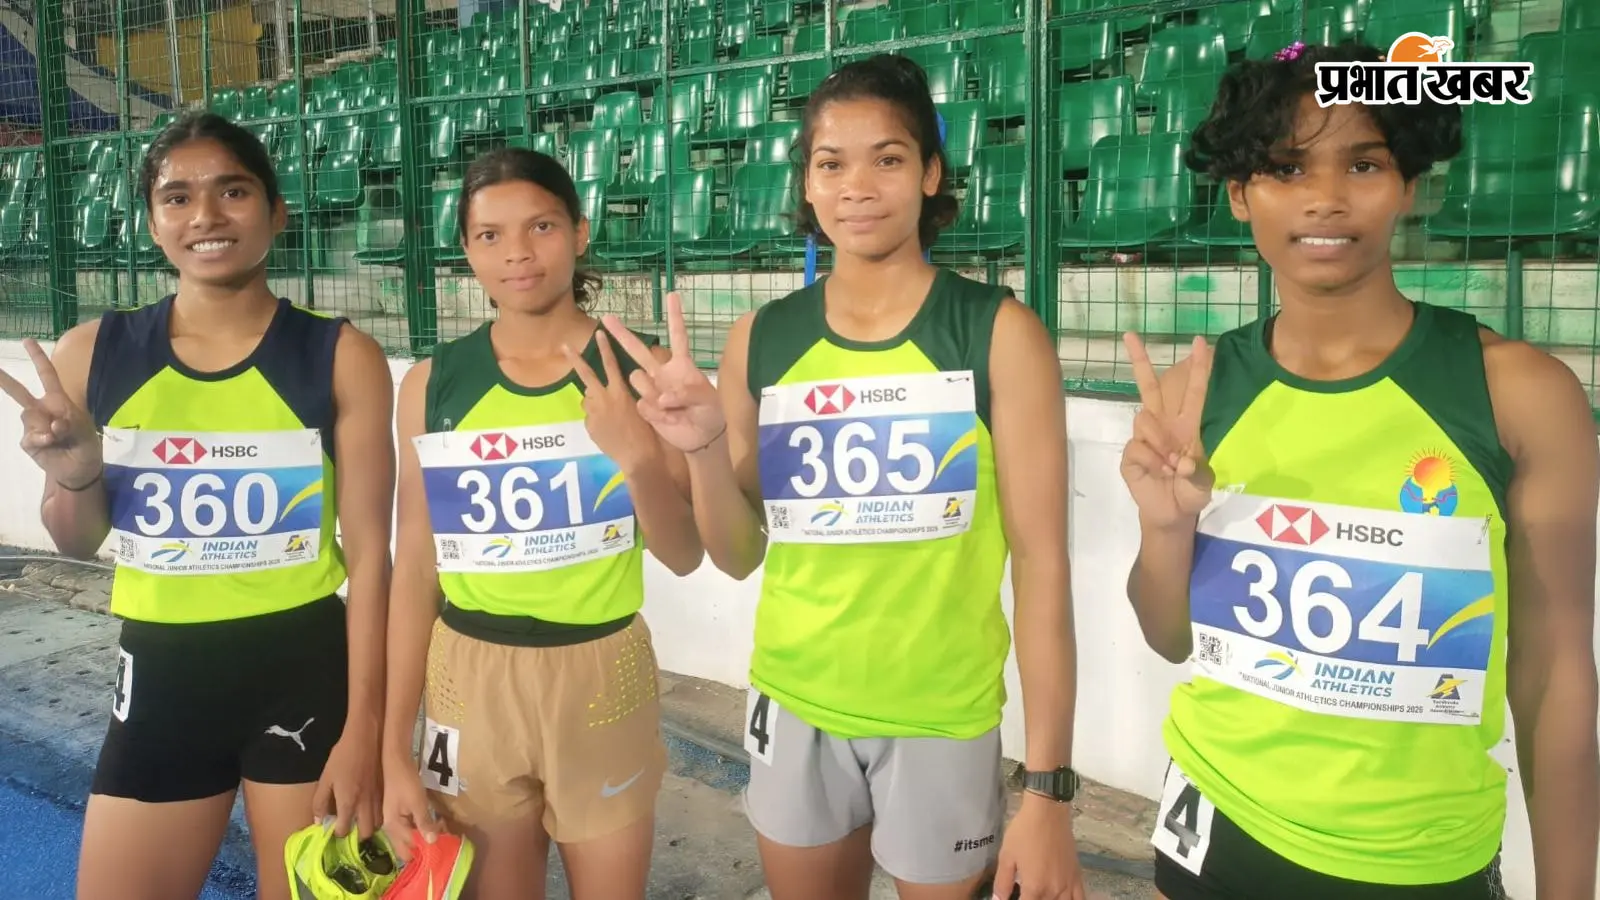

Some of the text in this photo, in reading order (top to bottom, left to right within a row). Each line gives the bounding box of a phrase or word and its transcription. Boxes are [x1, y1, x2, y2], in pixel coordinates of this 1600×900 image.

[860, 387, 907, 404] HSBC
[212, 445, 258, 458] HSBC
[522, 434, 566, 450] HSBC
[788, 419, 935, 498] 365
[132, 472, 278, 536] 360
[457, 461, 584, 533] 361
[857, 500, 914, 513] INDIAN
[856, 513, 914, 524] ATHLETICS
[524, 531, 576, 547] INDIAN
[1336, 522, 1404, 547] HSBC
[202, 540, 258, 552] INDIAN
[524, 542, 577, 556] ATHLETICS
[200, 551, 257, 561] ATHLETICS
[1231, 549, 1430, 663] 364
[1314, 661, 1395, 685] INDIAN
[1242, 674, 1271, 690] NATIONAL
[1272, 683, 1295, 697] JUNIOR
[1296, 691, 1337, 706] ATHLETICS
[1339, 699, 1405, 713] CHAMPIONSHIPS
[1310, 679, 1392, 698] ATHLETICS
[749, 694, 770, 756] 4
[428, 732, 453, 786] 4
[1164, 782, 1201, 859] 4
[954, 834, 995, 853] #itsme
